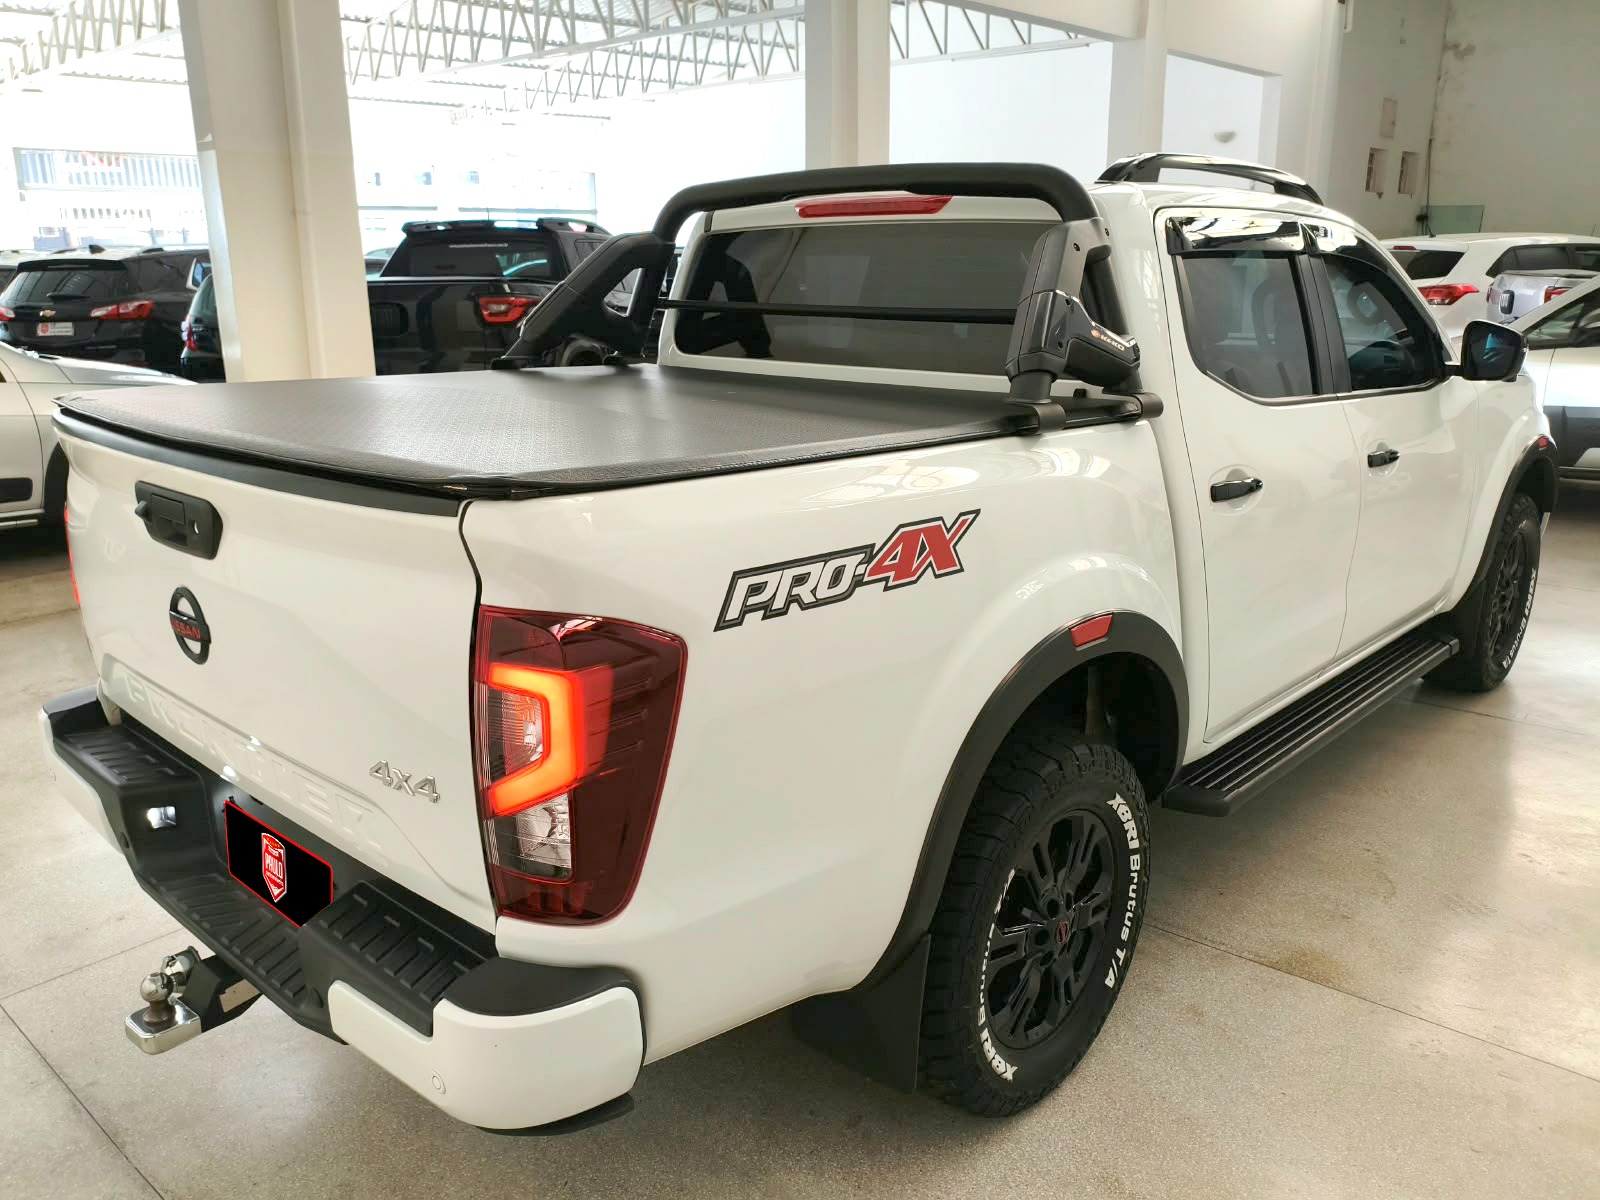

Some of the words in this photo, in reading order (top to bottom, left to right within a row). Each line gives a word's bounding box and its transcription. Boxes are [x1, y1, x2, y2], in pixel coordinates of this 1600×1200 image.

[713, 508, 981, 632] PRO-4X
[1120, 853, 1141, 942] Brutus
[1104, 948, 1126, 989] T/A
